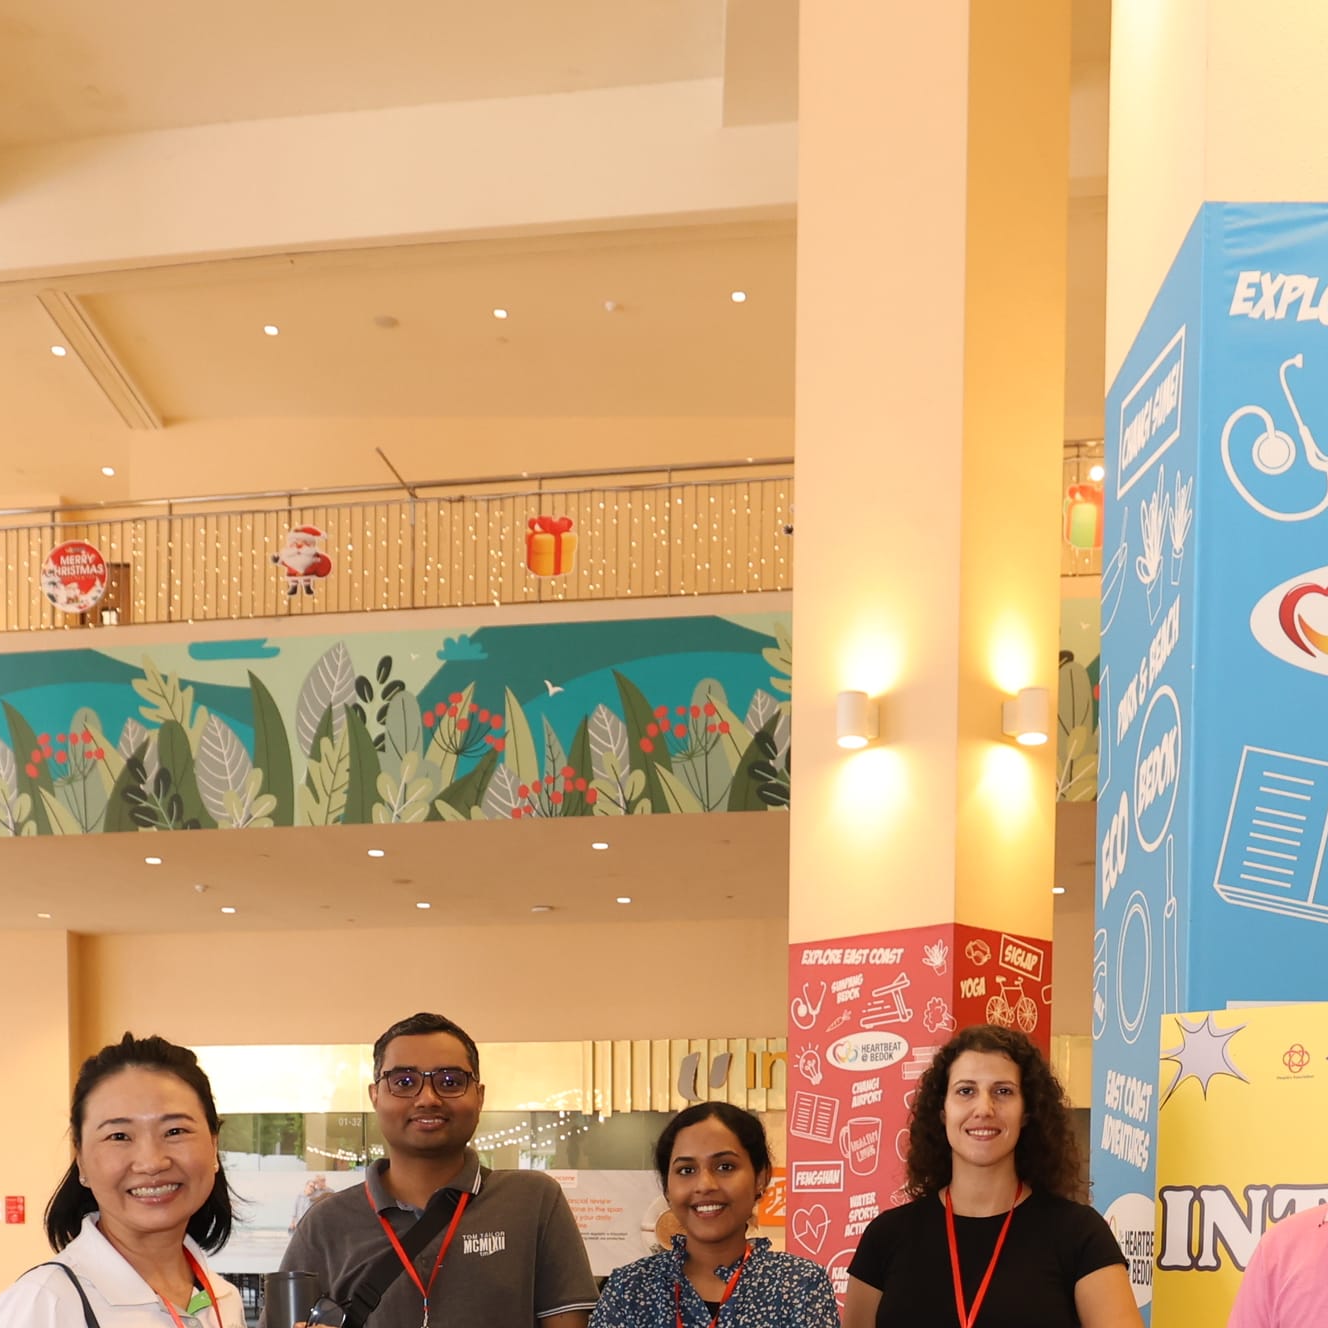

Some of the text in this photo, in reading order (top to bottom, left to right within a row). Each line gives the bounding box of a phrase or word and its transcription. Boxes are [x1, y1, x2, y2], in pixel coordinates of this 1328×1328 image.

[60, 553, 96, 566] MERRY
[1148, 593, 1181, 677] BEACH
[1137, 725, 1178, 819] BEDOK
[1102, 789, 1129, 910] ECO
[801, 947, 905, 966] EXPLORE EAST COAST
[1004, 944, 1039, 972] SIGLAP
[836, 986, 861, 1005] BEDOK
[959, 975, 987, 999] YOGA
[861, 1041, 902, 1053] HEARTBEAT
[869, 1051, 894, 1062] BEDOK
[851, 1077, 880, 1094] CHANGI
[851, 1089, 884, 1109] AIRPORT
[1104, 1069, 1154, 1123] EAST COAST
[850, 1129, 880, 1153] HEALTHY
[1101, 1113, 1150, 1173] ADVENTURES
[795, 1169, 841, 1186] FENGSHAN
[849, 1192, 877, 1209] WATER
[848, 1206, 880, 1223] SPORTS
[462, 1231, 506, 1241] TOM TAILOR
